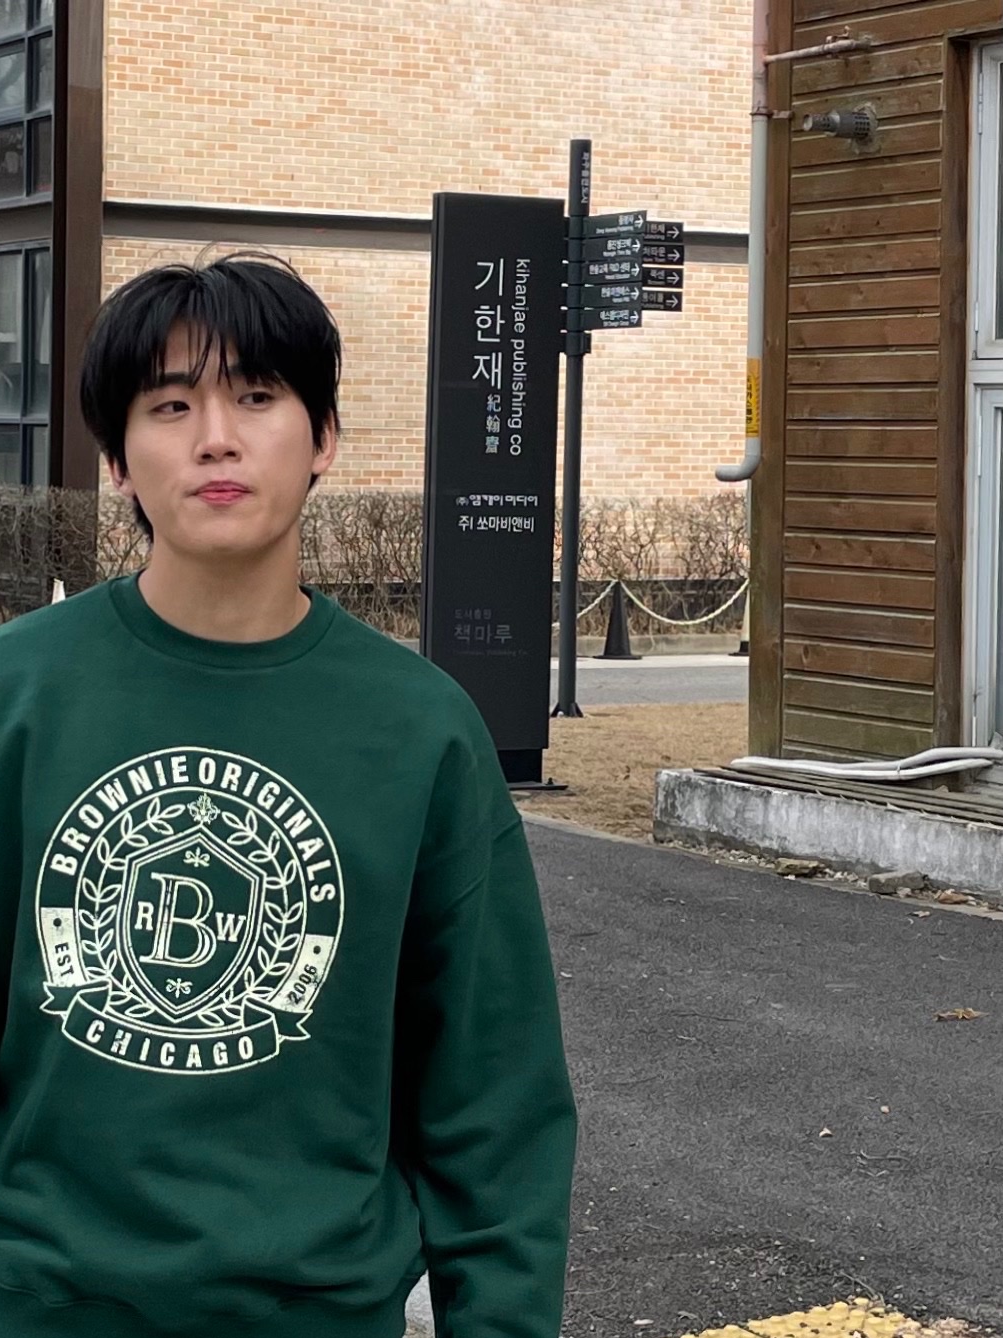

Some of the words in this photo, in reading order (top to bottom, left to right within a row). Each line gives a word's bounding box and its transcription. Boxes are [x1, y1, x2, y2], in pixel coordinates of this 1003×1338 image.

[472, 258, 506, 390] 기한재
[508, 339, 528, 429] publishing
[509, 434, 522, 456] co
[454, 623, 513, 644] 책마루
[49, 755, 190, 877] BROWNIE
[198, 756, 336, 903] ORIGINALS
[134, 901, 154, 931] R
[139, 872, 217, 968] B
[215, 911, 247, 943] W
[54, 941, 75, 977] EST
[288, 963, 318, 1005] 2006
[85, 1019, 255, 1069] CHICAGO
